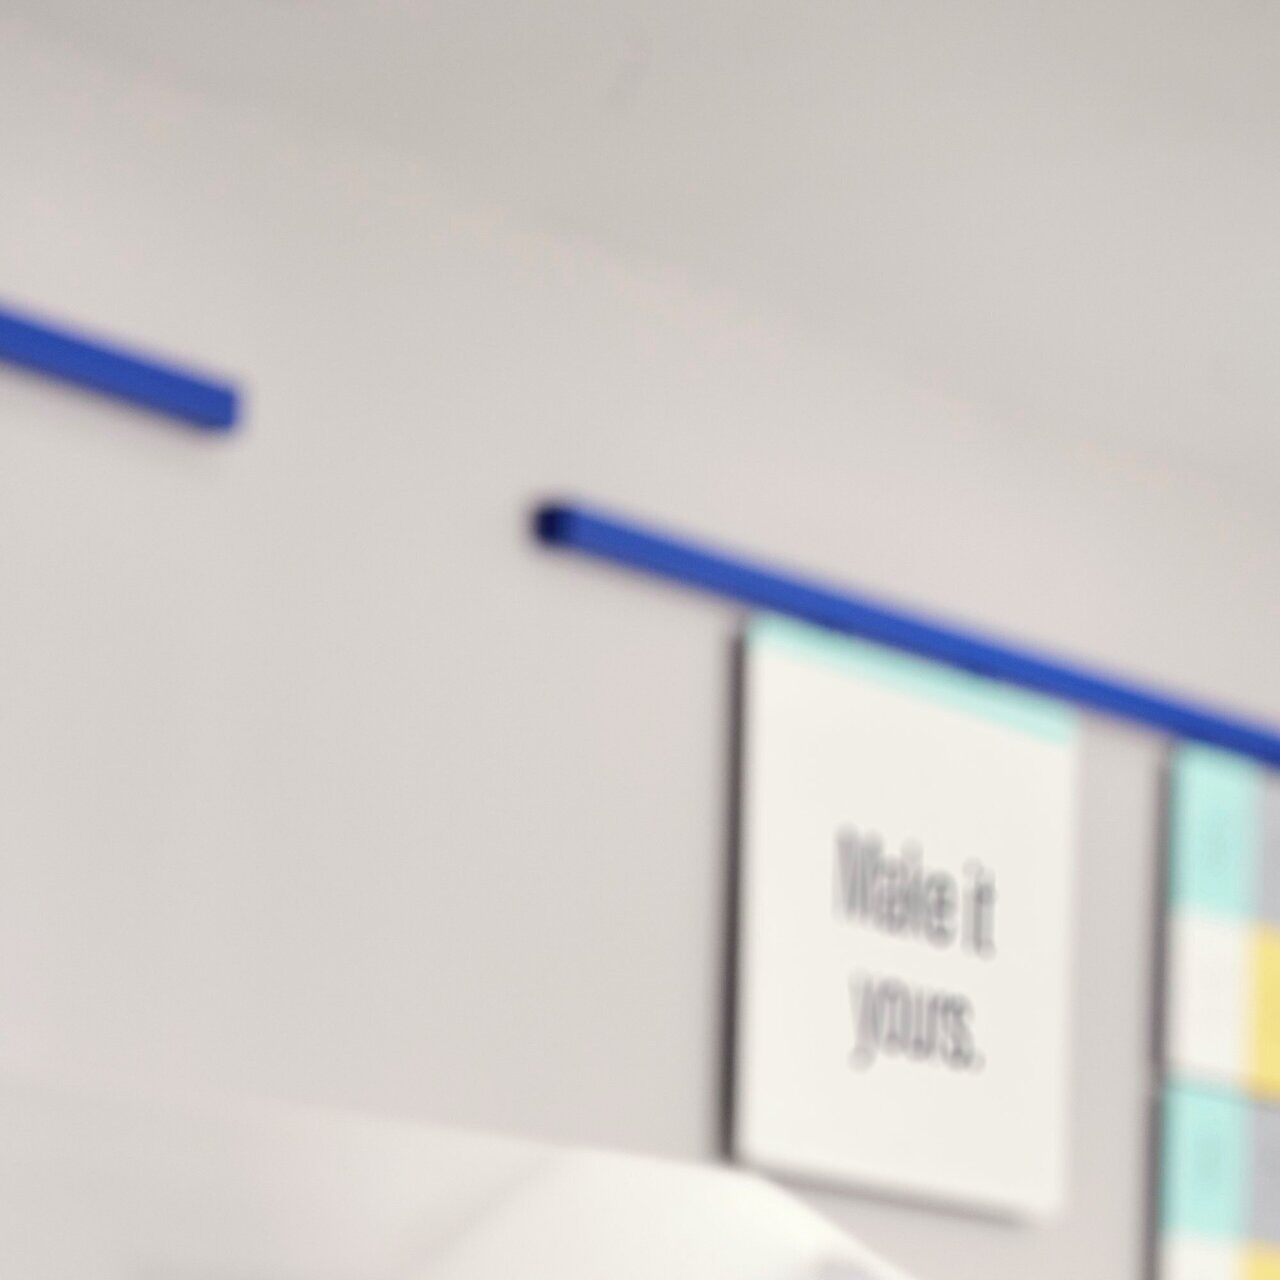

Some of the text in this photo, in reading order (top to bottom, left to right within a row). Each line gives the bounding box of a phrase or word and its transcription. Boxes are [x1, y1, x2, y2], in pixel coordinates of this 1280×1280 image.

[834, 822, 998, 962] Make it
[848, 970, 987, 1075] yours.
